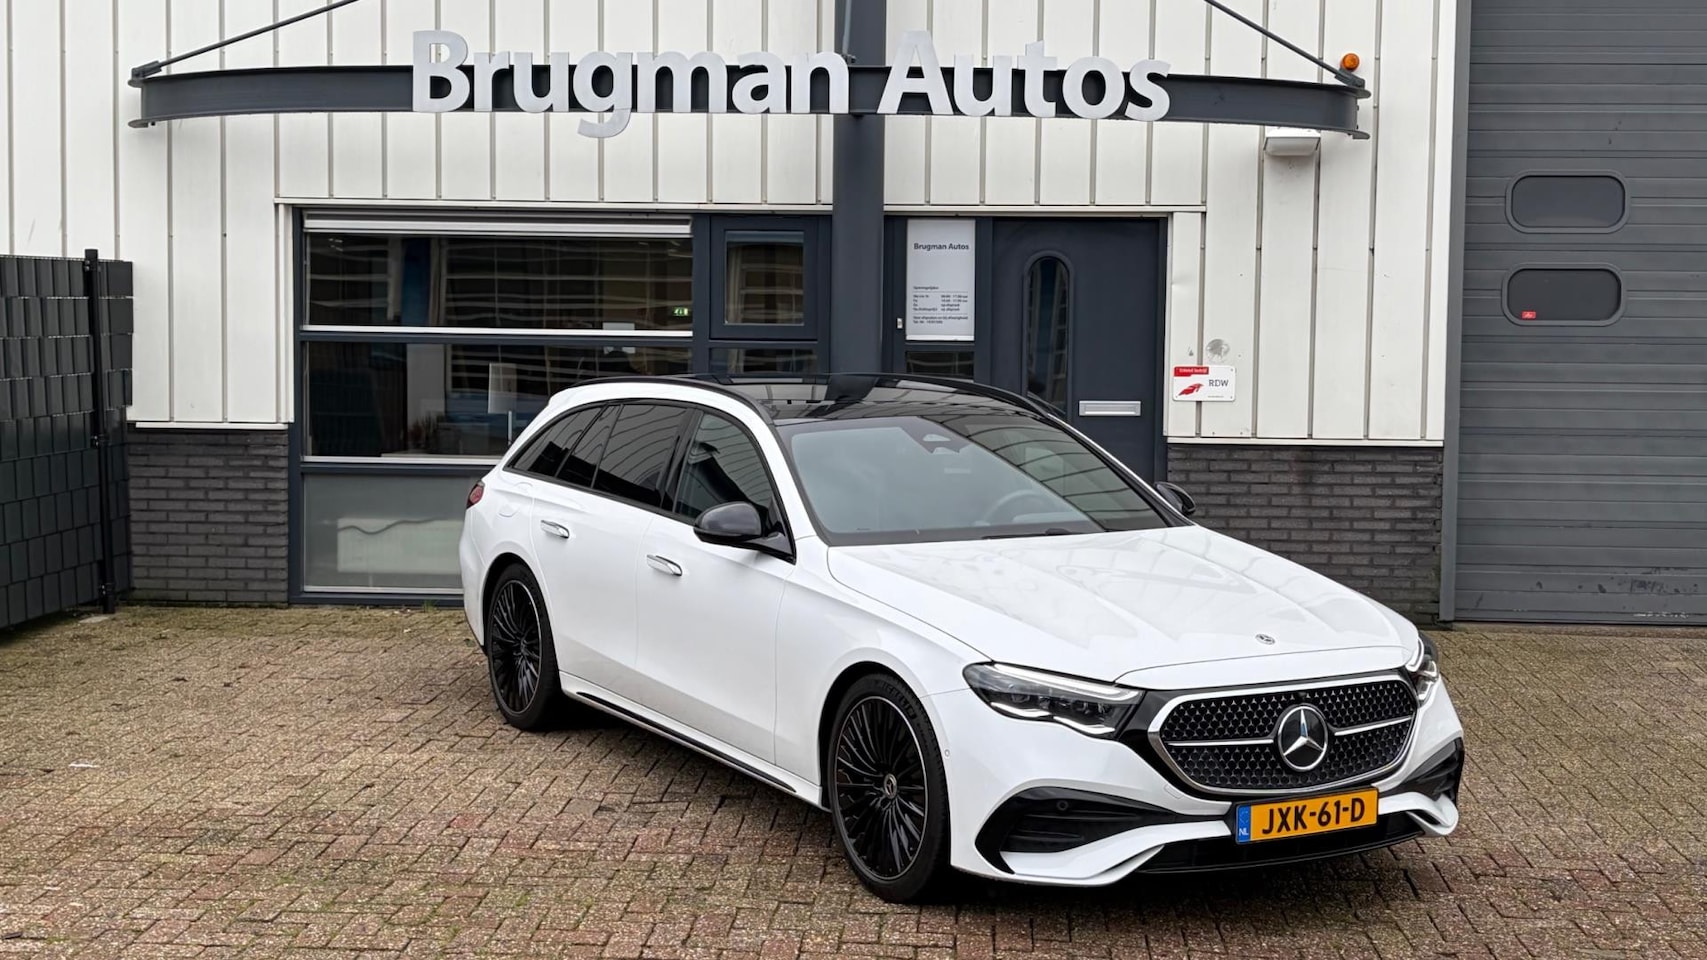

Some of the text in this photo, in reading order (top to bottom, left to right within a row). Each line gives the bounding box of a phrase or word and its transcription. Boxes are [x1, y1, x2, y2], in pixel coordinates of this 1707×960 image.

[413, 30, 1172, 138] Brugman Autos
[914, 243, 947, 251] Brugman
[1262, 798, 1365, 834] JXK-61-D
[1238, 827, 1249, 836] NL
